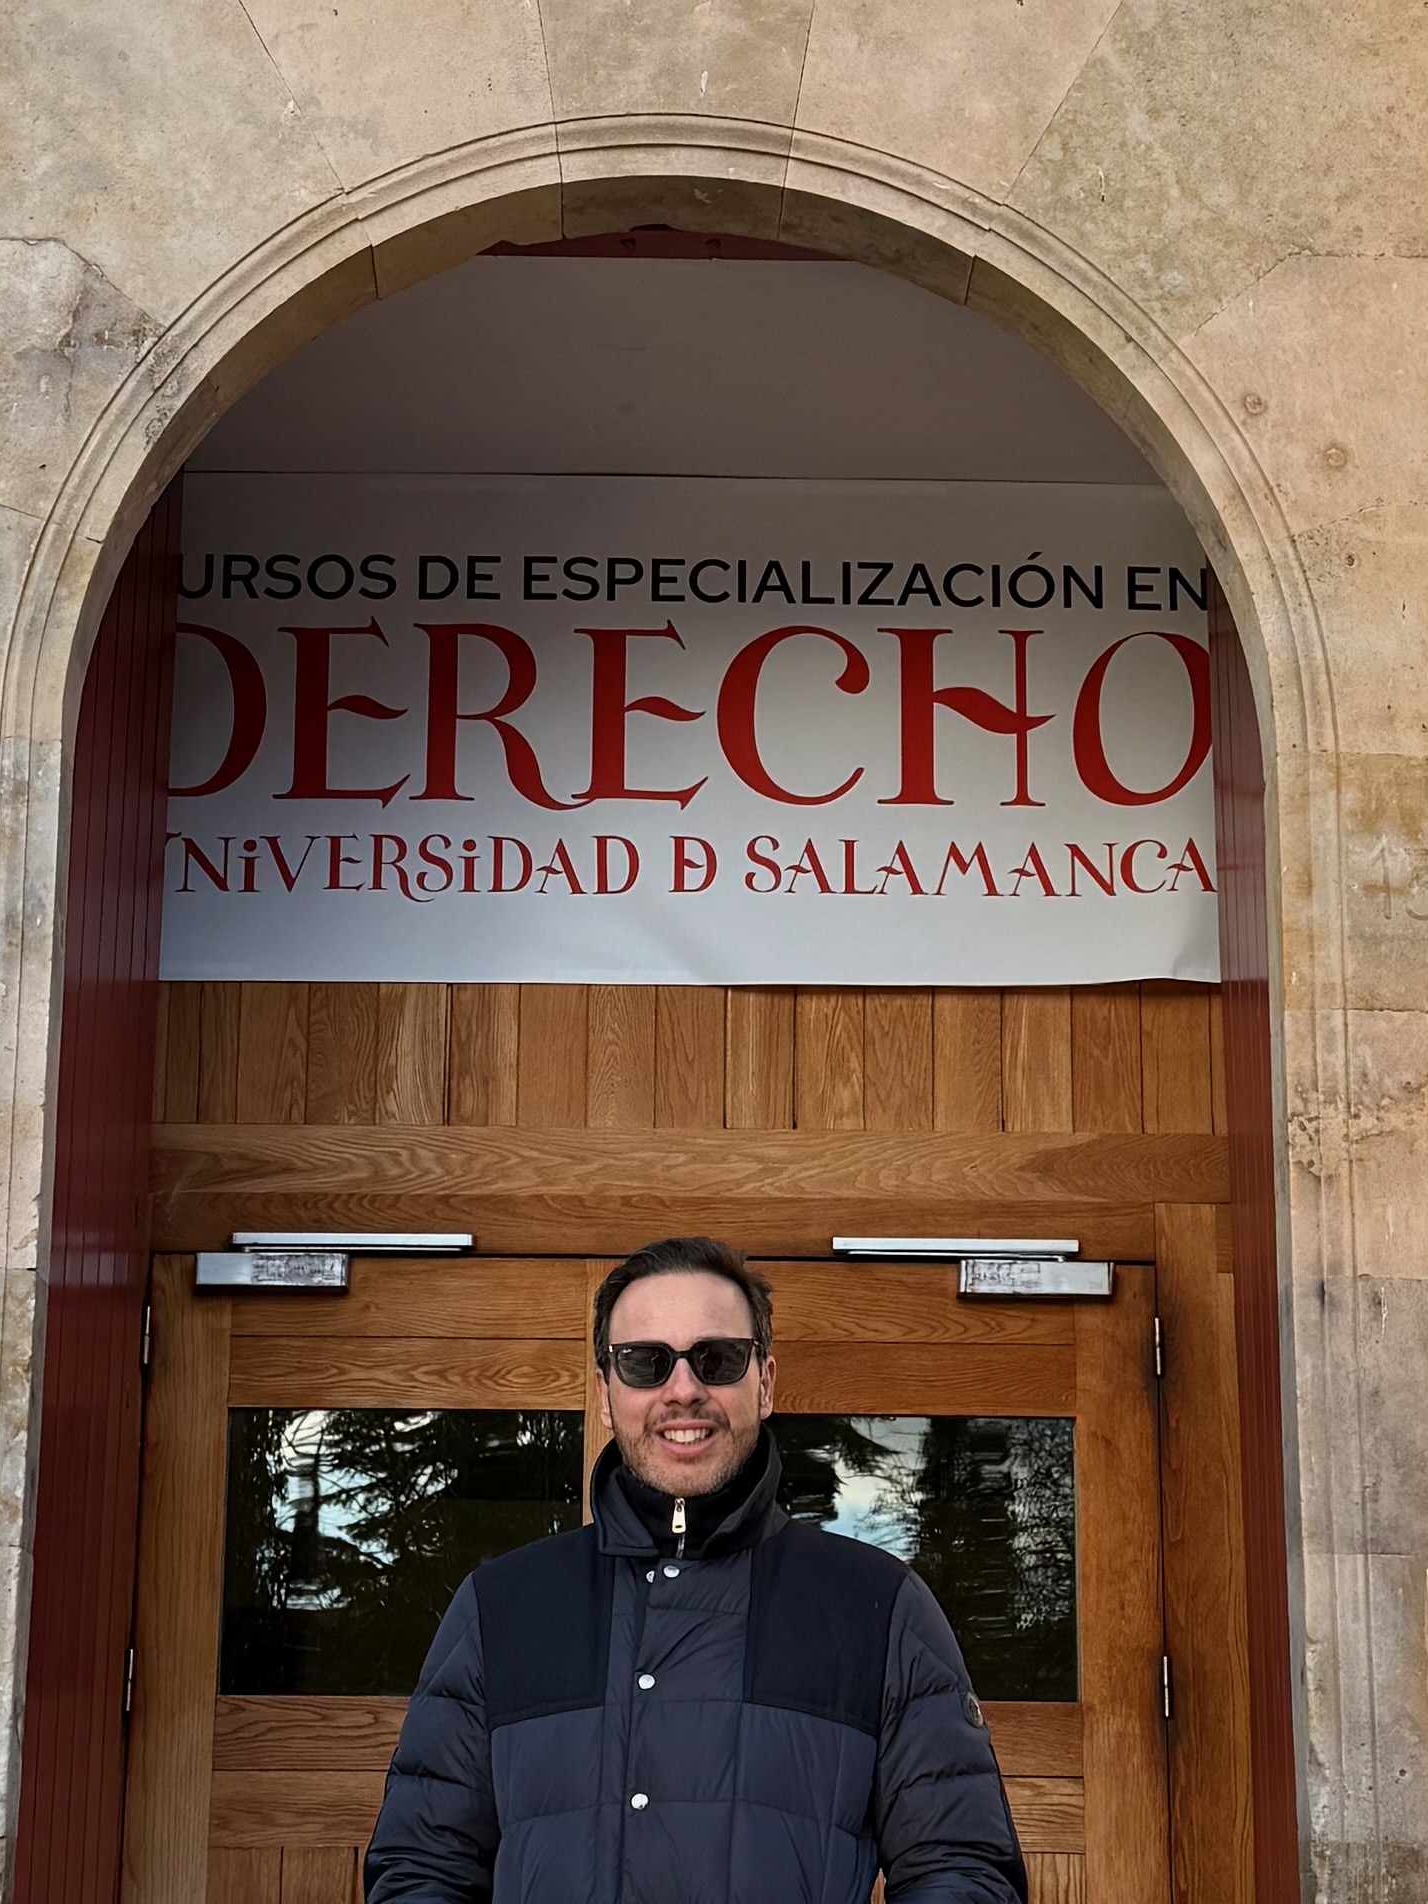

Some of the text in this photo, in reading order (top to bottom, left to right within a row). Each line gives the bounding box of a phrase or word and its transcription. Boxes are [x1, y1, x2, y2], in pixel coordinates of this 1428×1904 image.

[418, 554, 503, 601] DE
[522, 551, 1105, 610] ESPECIALIZACIÓN
[1126, 565, 1208, 612] EN
[167, 615, 1213, 811] DERECHO
[744, 834, 1219, 898] SALAMANCA
